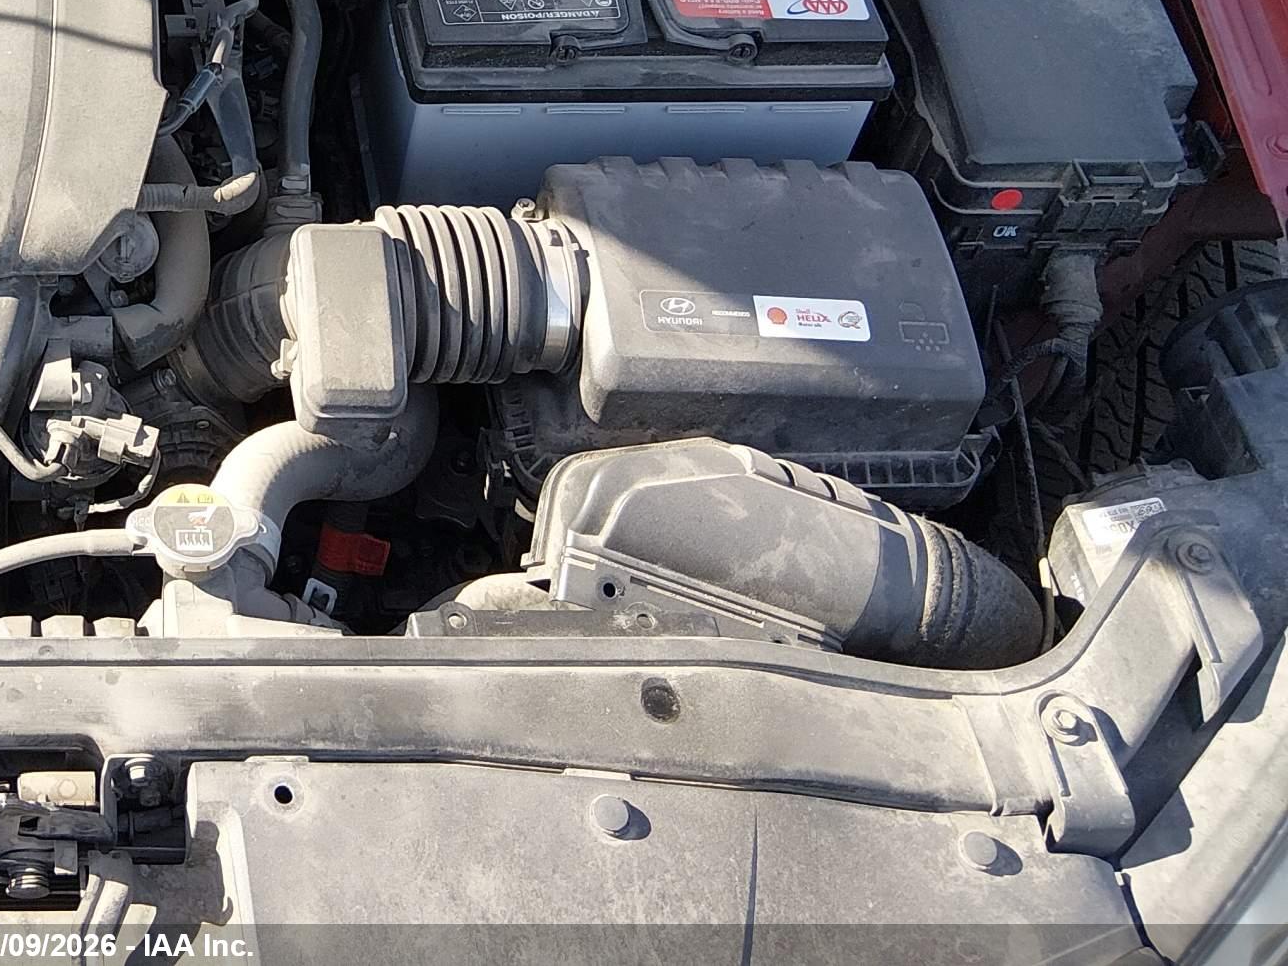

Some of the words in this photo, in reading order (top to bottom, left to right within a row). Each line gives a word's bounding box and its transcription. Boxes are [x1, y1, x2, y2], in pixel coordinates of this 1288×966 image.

[501, 9, 591, 21] DANGER/POISON
[657, 316, 703, 326] HYUNDAI
[797, 313, 832, 323] HELIX
